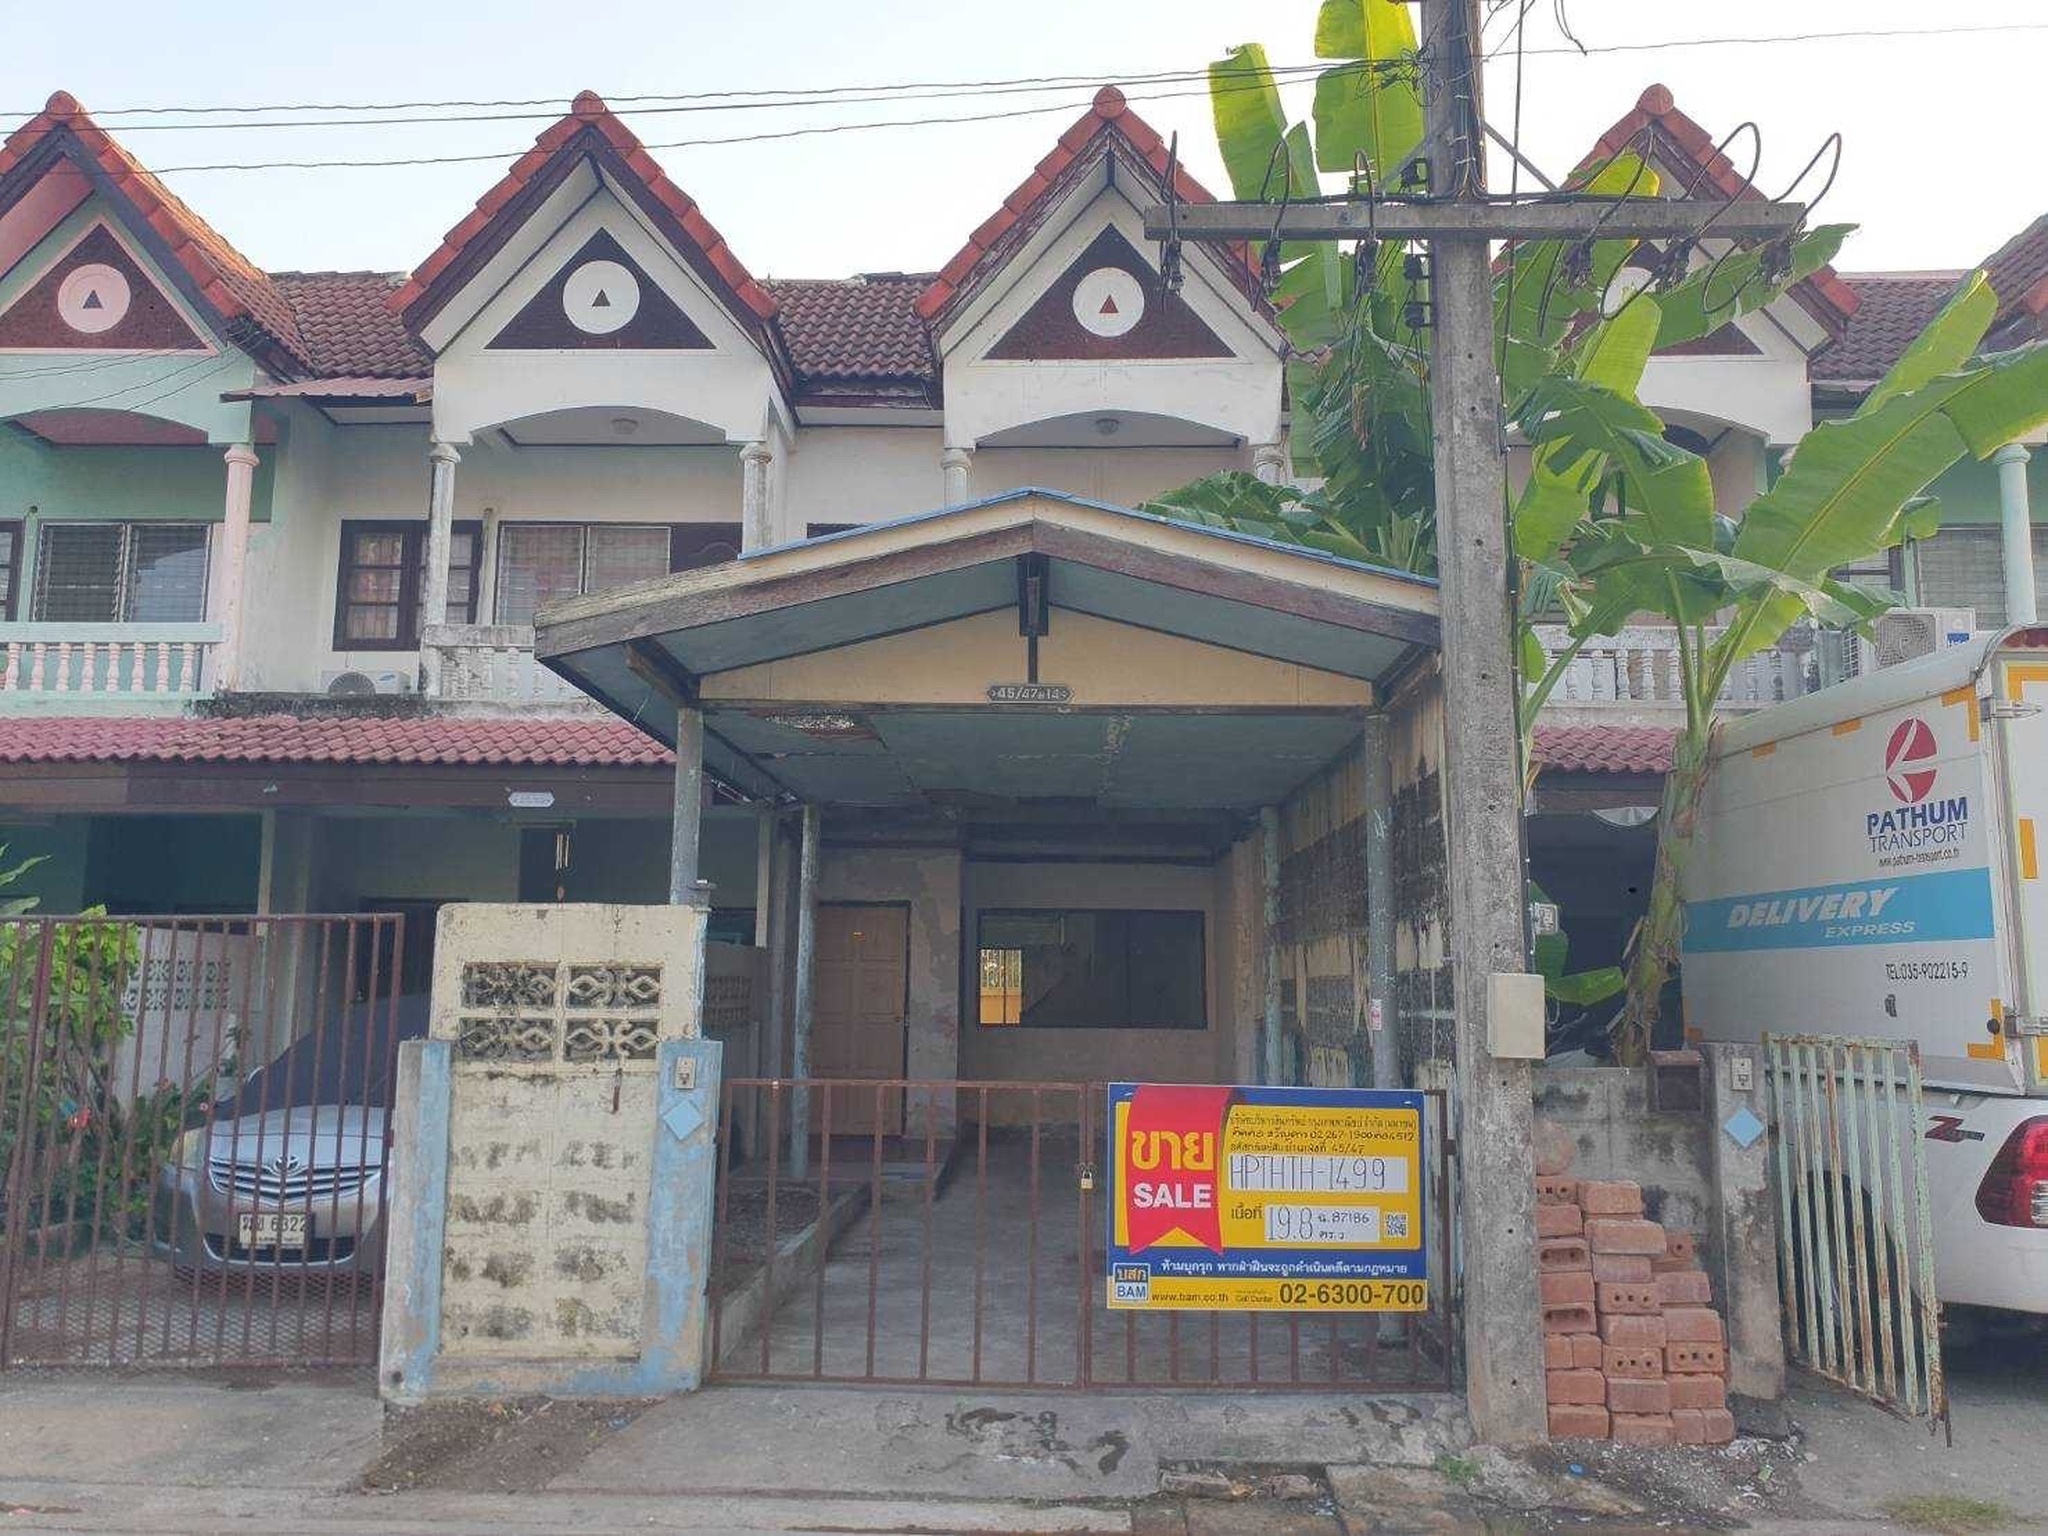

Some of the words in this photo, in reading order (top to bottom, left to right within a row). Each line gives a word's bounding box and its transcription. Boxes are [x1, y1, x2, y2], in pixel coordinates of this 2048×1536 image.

[1867, 797, 1968, 835] PATHUM
[1869, 822, 1968, 853] TRANSPORT
[1728, 887, 1898, 928] DELIVERY
[1825, 921, 1916, 938] EXPRESS
[1132, 1131, 1214, 1170] ขาย
[1230, 1155, 1385, 1190] HPTHTH-1499
[1133, 1183, 1212, 1208] SALE
[1231, 1203, 1262, 1220] เนื้อที่
[1269, 1206, 1314, 1241] 19.8
[1161, 1259, 1213, 1276] ห้ามบุกรุก
[1117, 1285, 1147, 1298] BAM
[1279, 1283, 1424, 1304] 02-6300-700
